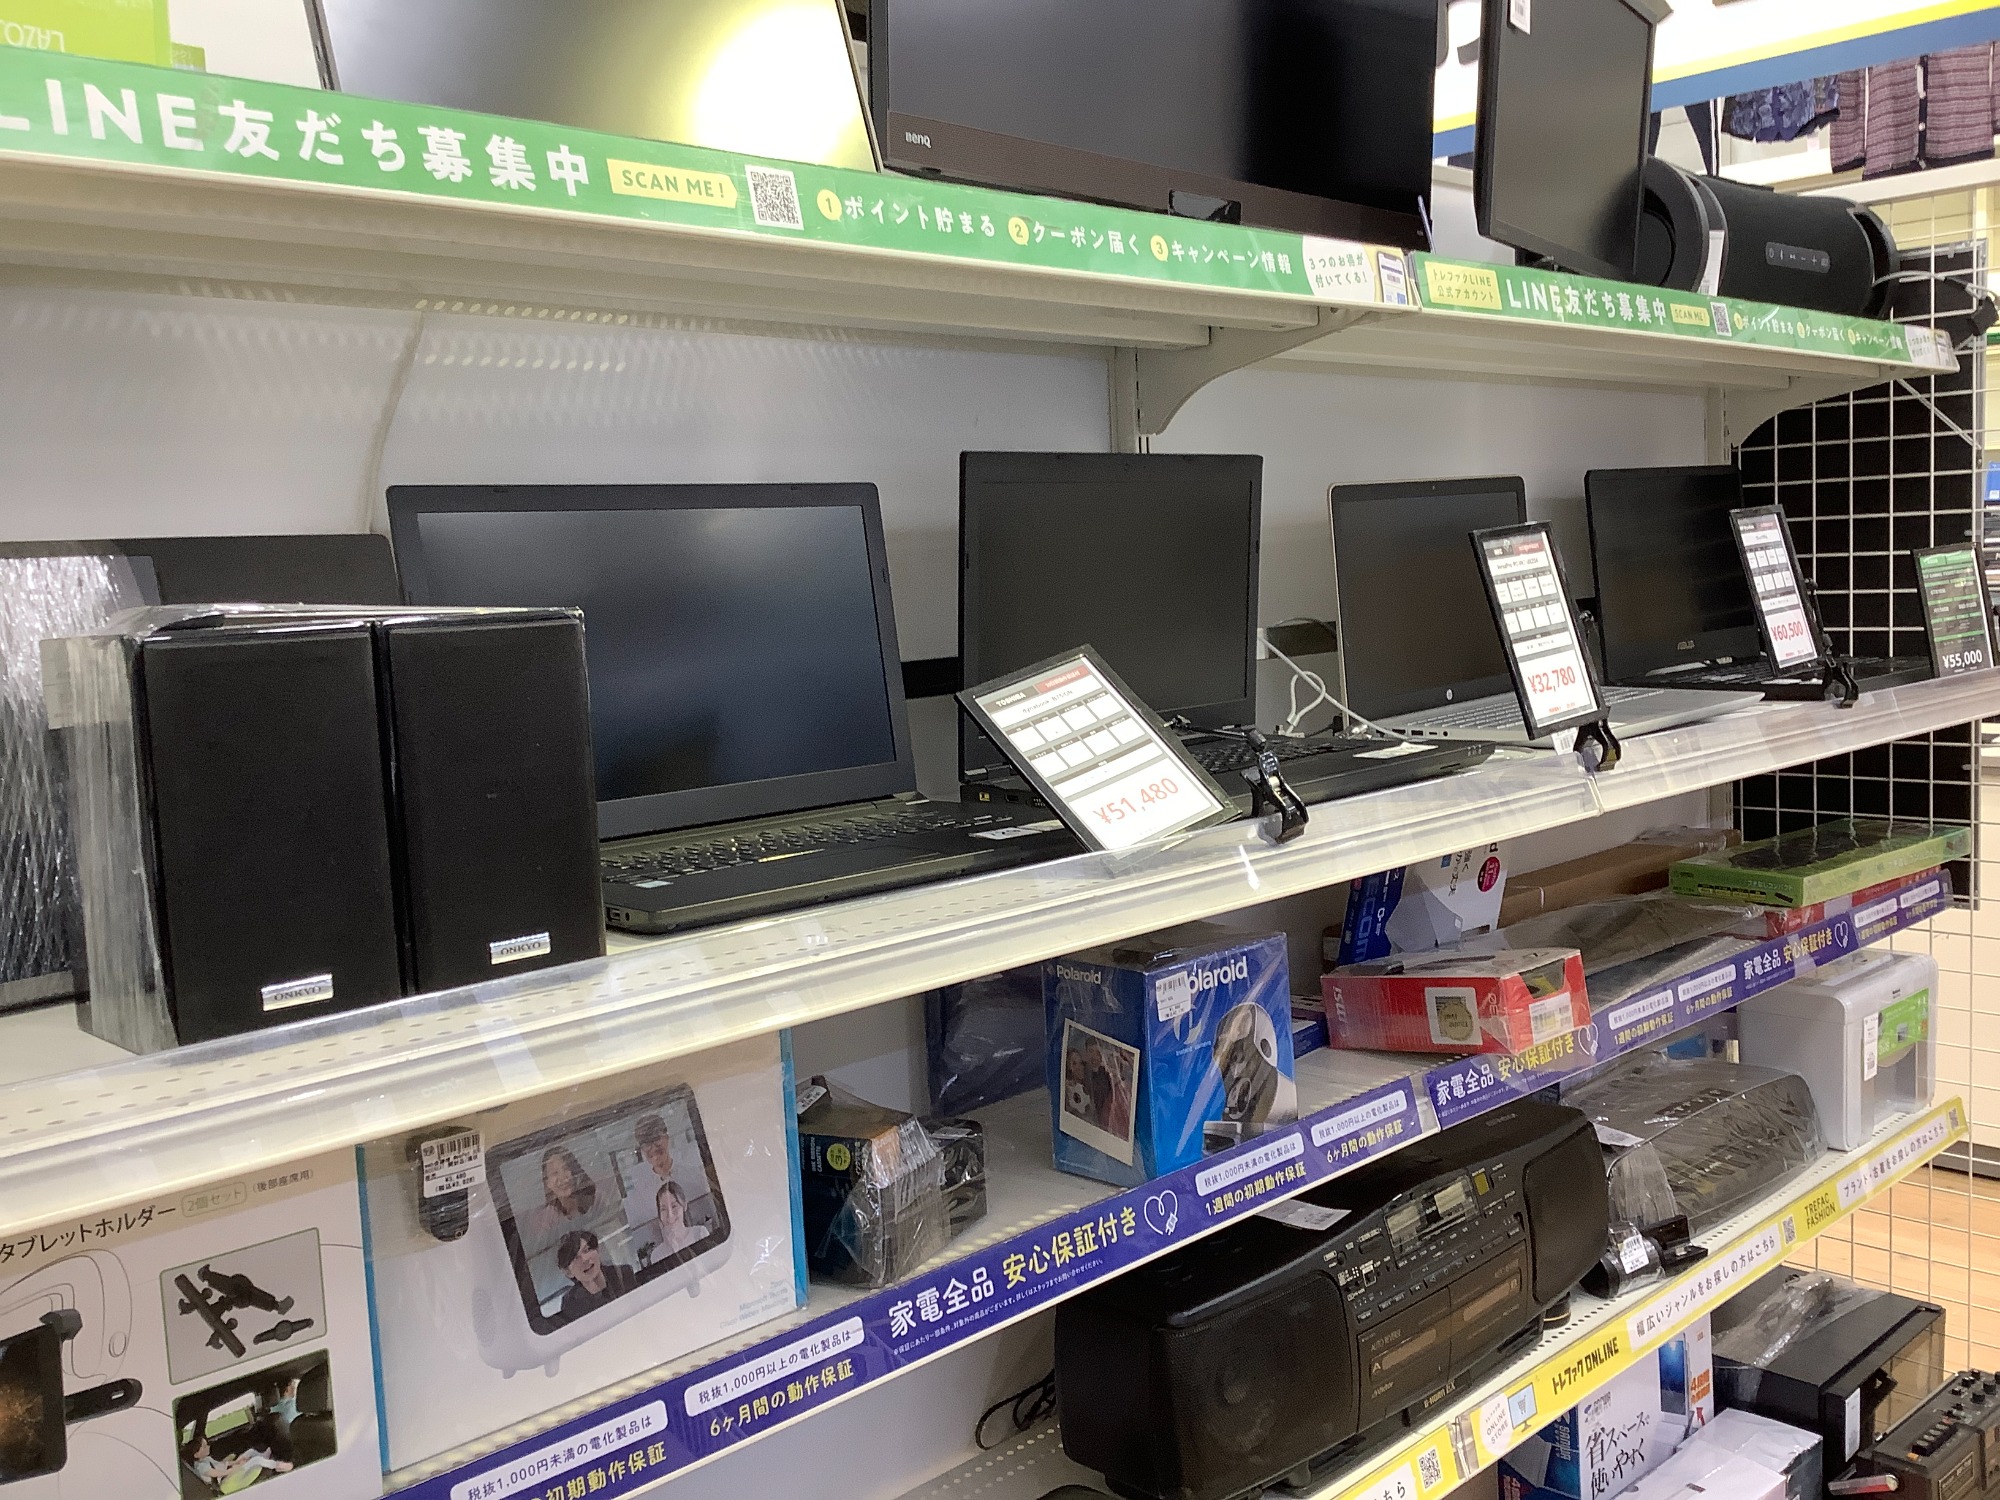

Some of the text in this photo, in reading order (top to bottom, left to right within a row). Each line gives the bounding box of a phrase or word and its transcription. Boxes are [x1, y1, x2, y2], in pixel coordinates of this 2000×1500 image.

[0, 20, 65, 52] LAZO
[622, 169, 679, 195] SCAN
[844, 195, 995, 239] ポイント貯まる
[1033, 219, 1140, 256] クーポン届く
[1171, 238, 1293, 276] キャンペーン情報
[1770, 620, 1804, 642] ¥60,500
[1942, 649, 1983, 669] ¥55,000
[1527, 665, 1577, 695] ¥32,780
[995, 691, 1027, 708] TOSHIBA
[1092, 777, 1180, 825] ¥51,480
[500, 940, 541, 956] ONKYO
[1743, 947, 1782, 981] 家電全品
[1056, 964, 1102, 986] Polaroid
[1187, 955, 1248, 995] olaroid
[273, 985, 323, 1001] ONKYO
[1436, 1063, 1494, 1107] 家電全品
[1804, 1192, 1830, 1217] TREFAC
[1806, 1203, 1836, 1230] FASHION
[0, 1204, 177, 1264] タブレットホルダー
[186, 1187, 243, 1212] 2個セット
[887, 1205, 1137, 1339] 家電全品 安心保証付き
[1636, 1235, 1776, 1338] 幅広いジャンルをお探しの方はこちら
[699, 1330, 852, 1406] 税抜1,000円以上の電化製品は
[1372, 1361, 1382, 1373] A
[1552, 1337, 1620, 1396] トレファク ONLINE
[1486, 1408, 1507, 1436] ONLINE
[1491, 1420, 1510, 1445] STORE
[467, 1414, 653, 1500] 税抜1,000円未満の電化製品は
[531, 1441, 667, 1500] 初期動作保証
